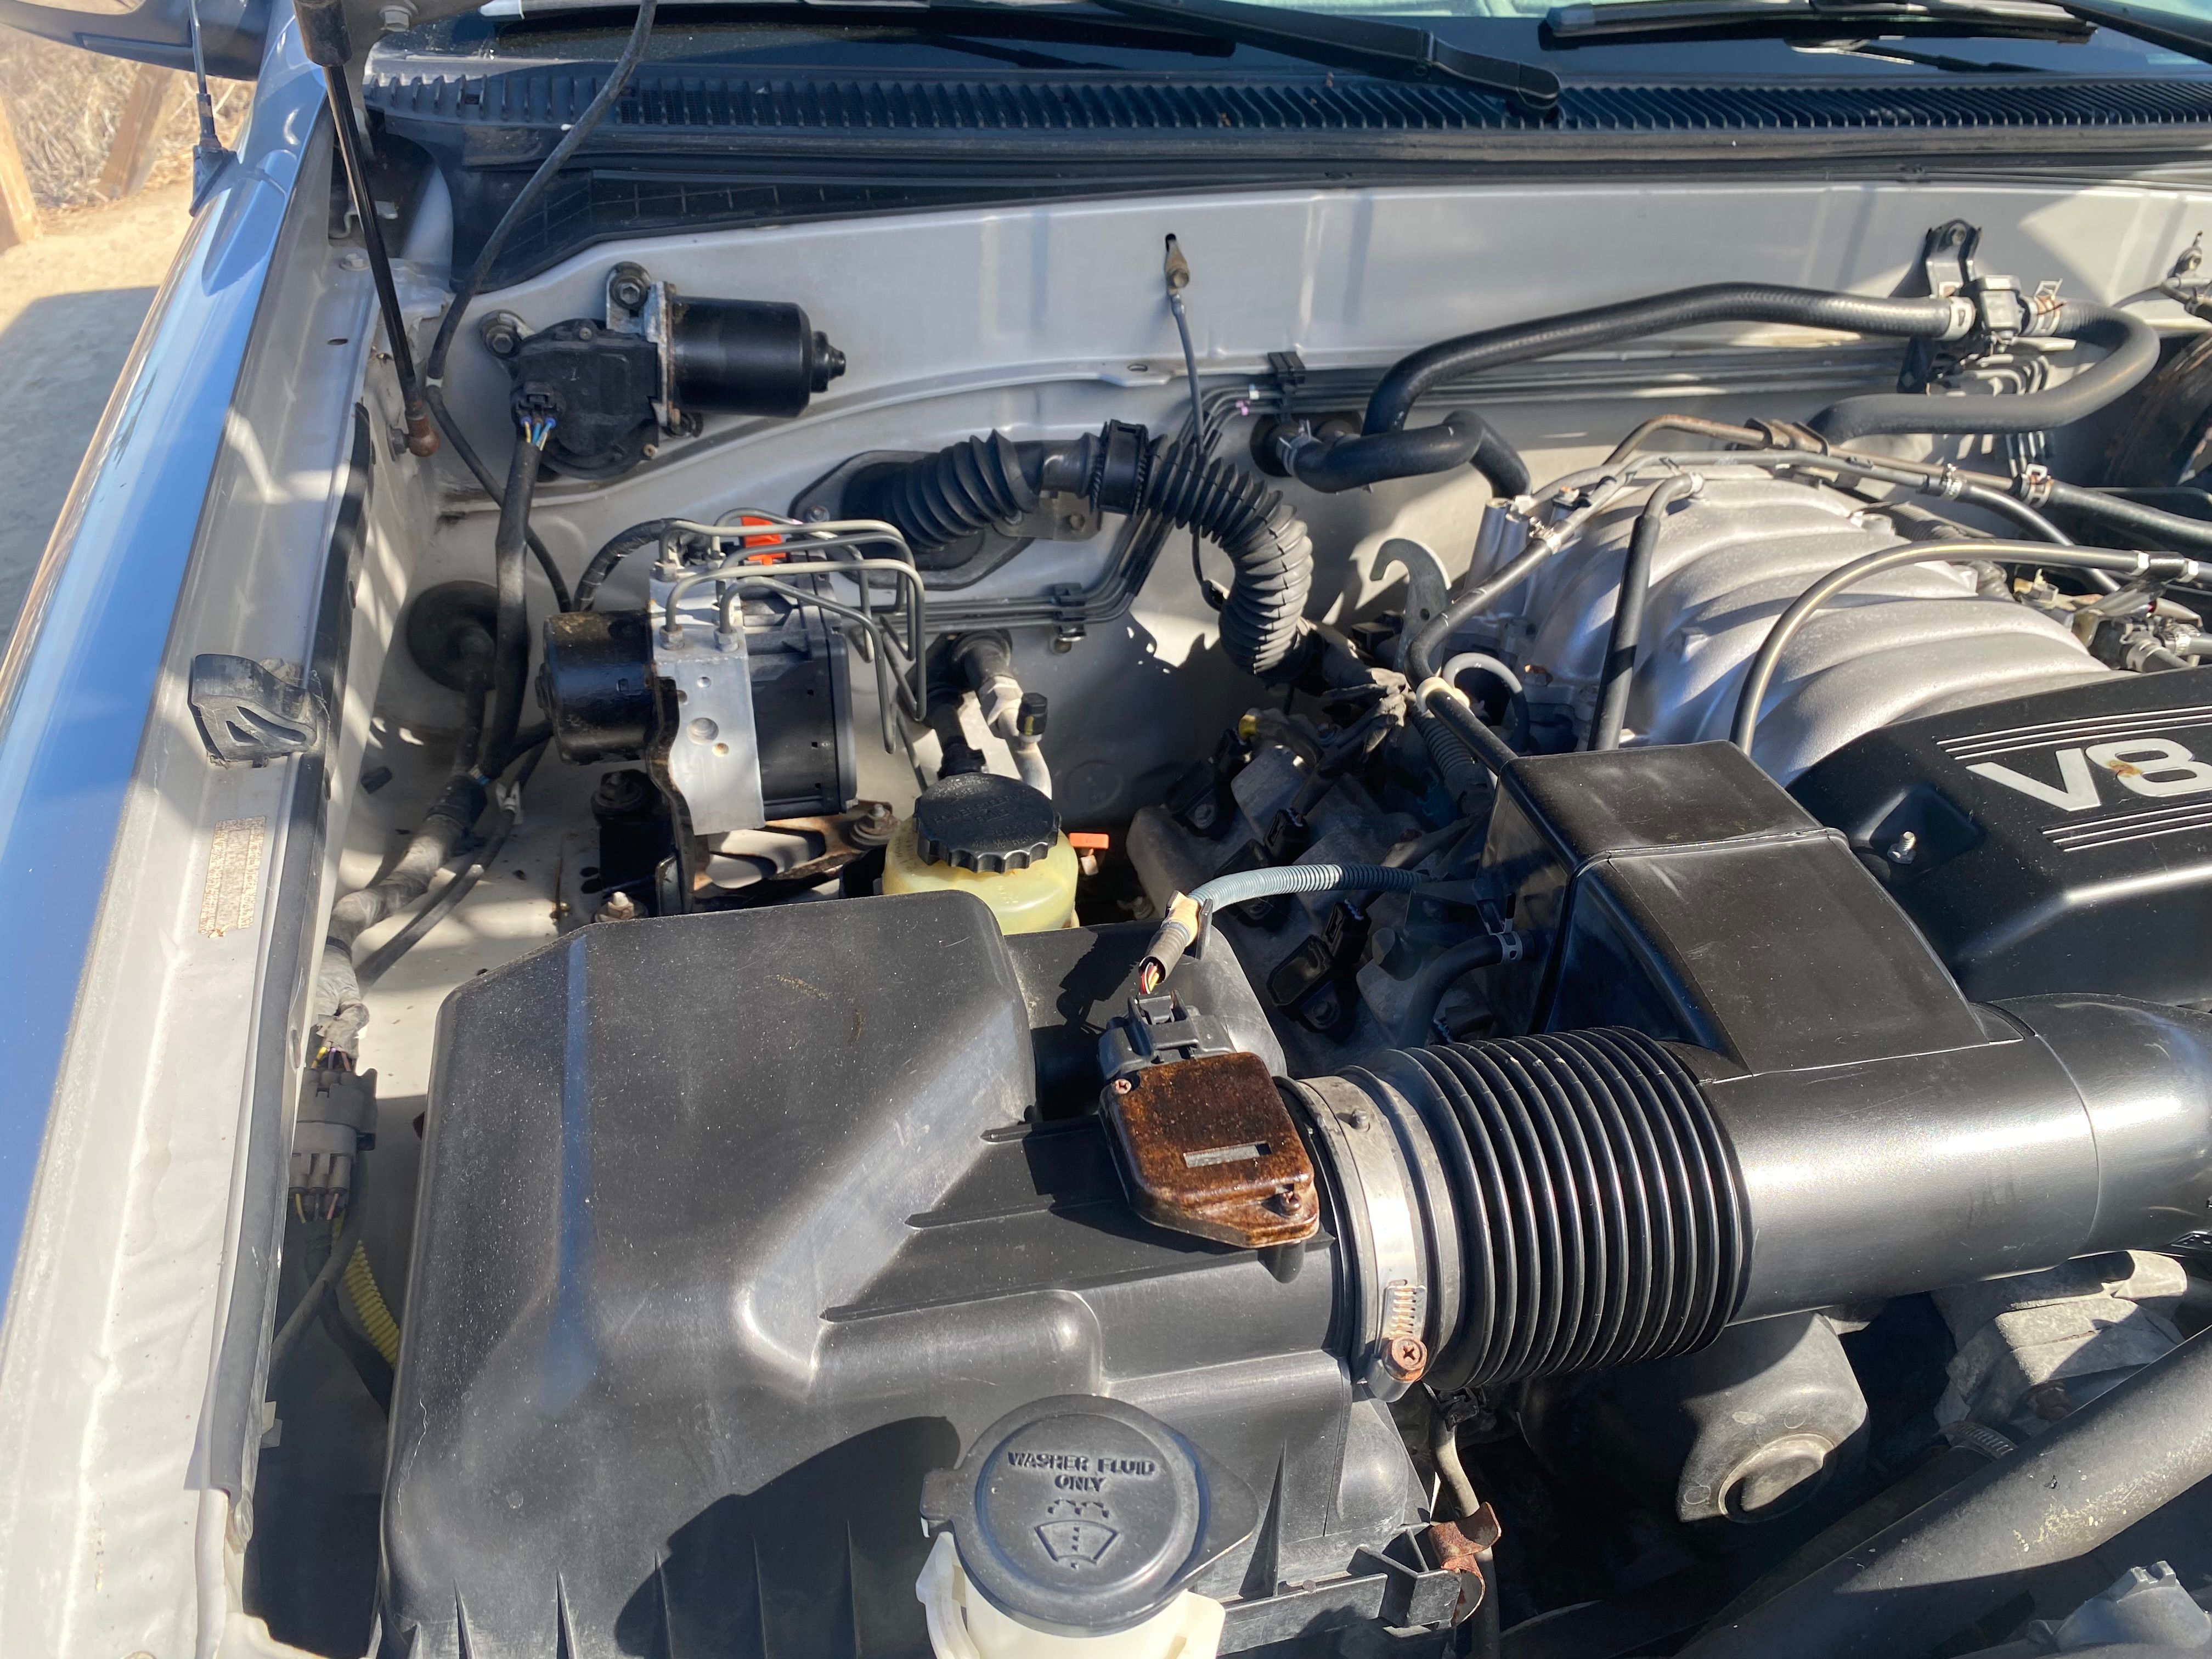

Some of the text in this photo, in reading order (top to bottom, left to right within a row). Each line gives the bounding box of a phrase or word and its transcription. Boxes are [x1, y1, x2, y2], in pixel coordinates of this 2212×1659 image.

[1965, 737, 2212, 812] V8
[1008, 1452, 1155, 1475] WASHER FLUID
[1054, 1474, 1107, 1492] ONLY
